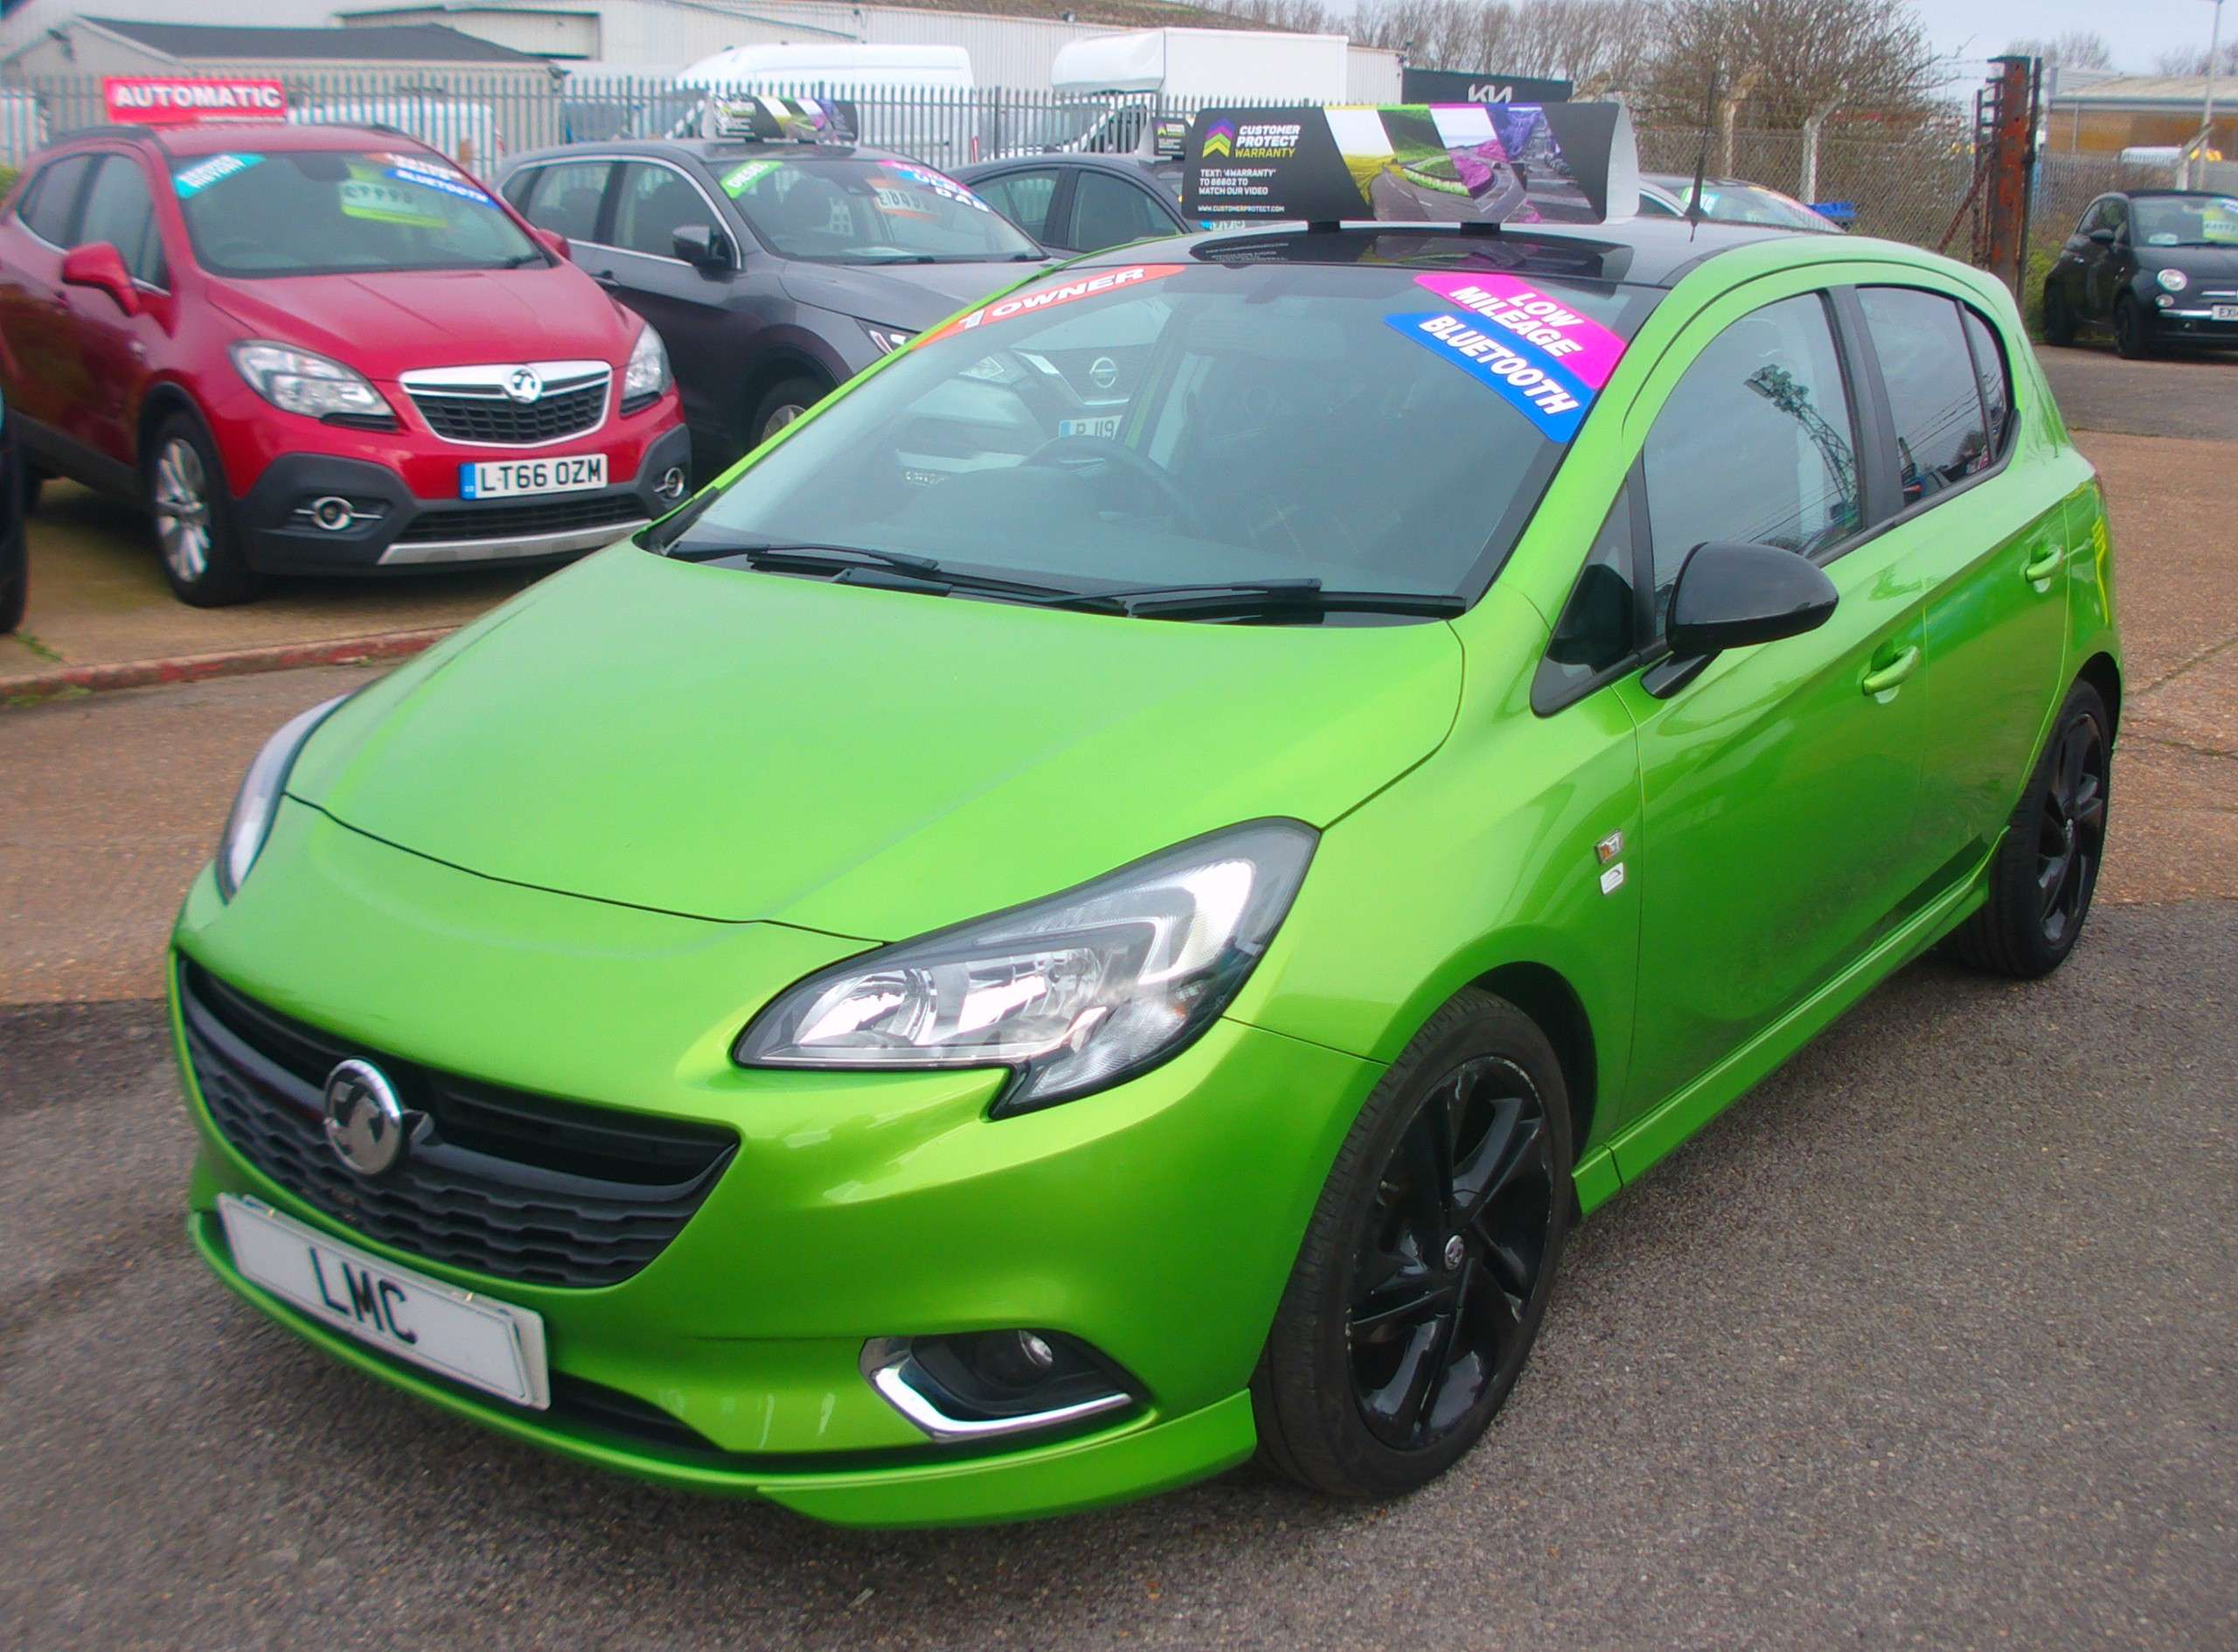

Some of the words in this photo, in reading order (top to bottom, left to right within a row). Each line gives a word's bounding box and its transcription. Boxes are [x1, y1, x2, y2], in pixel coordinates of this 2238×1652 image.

[115, 84, 283, 108] AUTOMATIC
[1467, 83, 1513, 103] KIA
[1235, 135, 1300, 148] PROTECT
[1239, 125, 1302, 135] CUSTOMER
[1234, 148, 1296, 158] WARRANTY
[1199, 177, 1210, 186] TO
[1238, 177, 1248, 186] TO
[1199, 186, 1226, 196] WATCH
[1227, 186, 1243, 196] OUR
[1245, 186, 1268, 196] VIDEO
[959, 309, 987, 330] 1
[991, 267, 1145, 316] OWNER
[1505, 292, 1585, 328] LOW
[1448, 286, 1584, 357] MILEAGE
[1418, 315, 1580, 415] BLUETOOTH
[481, 463, 547, 491] LT66
[555, 458, 601, 485] OZM
[309, 1246, 418, 1345] LMC
